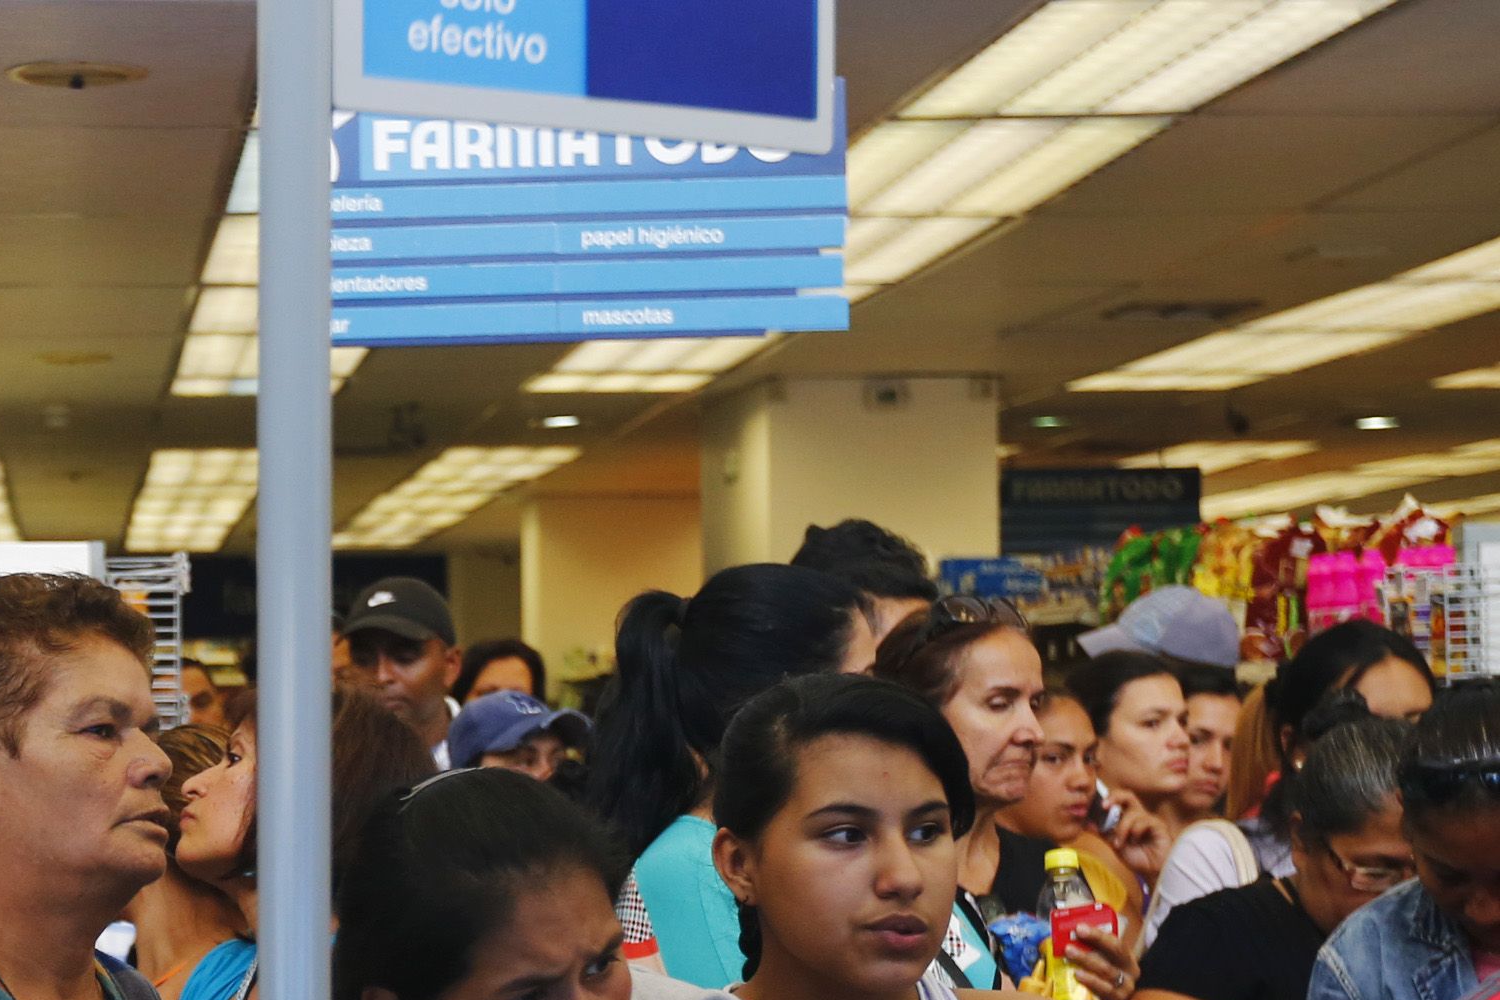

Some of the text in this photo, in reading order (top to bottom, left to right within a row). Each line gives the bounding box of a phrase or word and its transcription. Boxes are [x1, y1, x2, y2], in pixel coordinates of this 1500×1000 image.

[407, 13, 547, 64] efectivo
[581, 225, 725, 249] papel higiénico
[582, 307, 674, 326] mascotas
